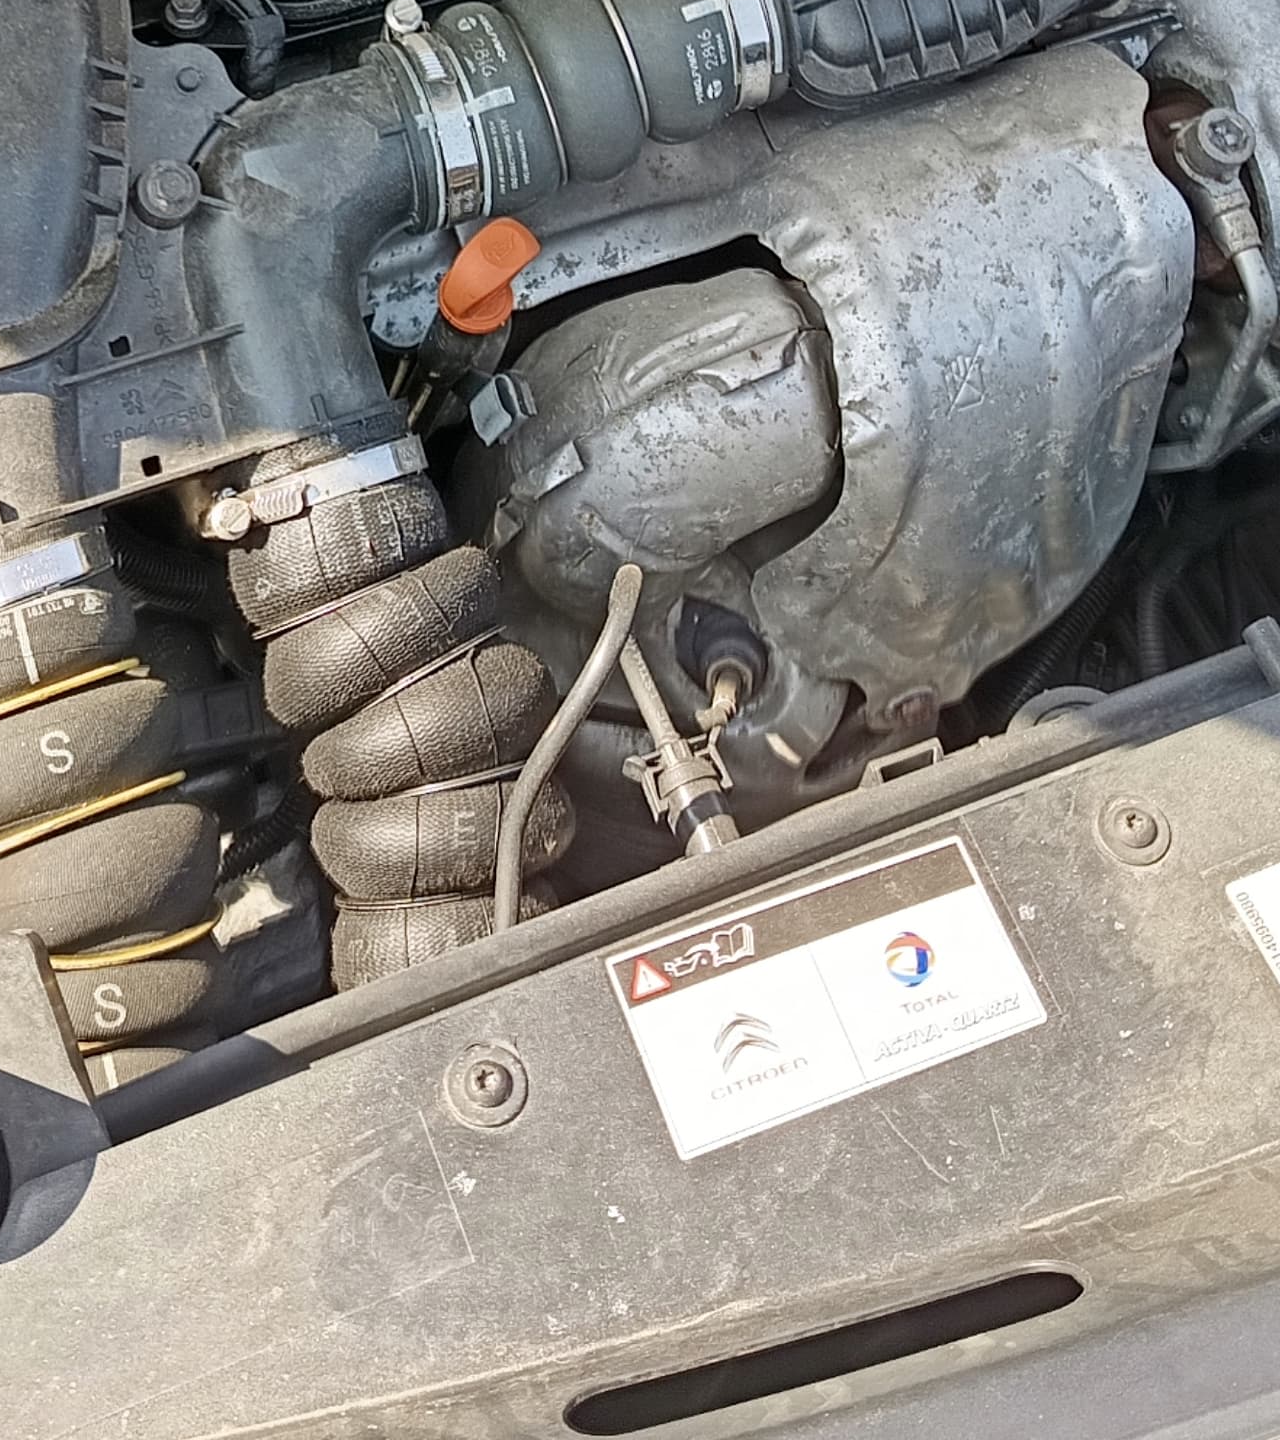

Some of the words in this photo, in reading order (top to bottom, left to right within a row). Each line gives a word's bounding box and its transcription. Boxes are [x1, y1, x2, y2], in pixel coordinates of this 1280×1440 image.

[39, 730, 75, 774] S
[93, 982, 128, 1028] S
[899, 990, 960, 1015] TOTAL
